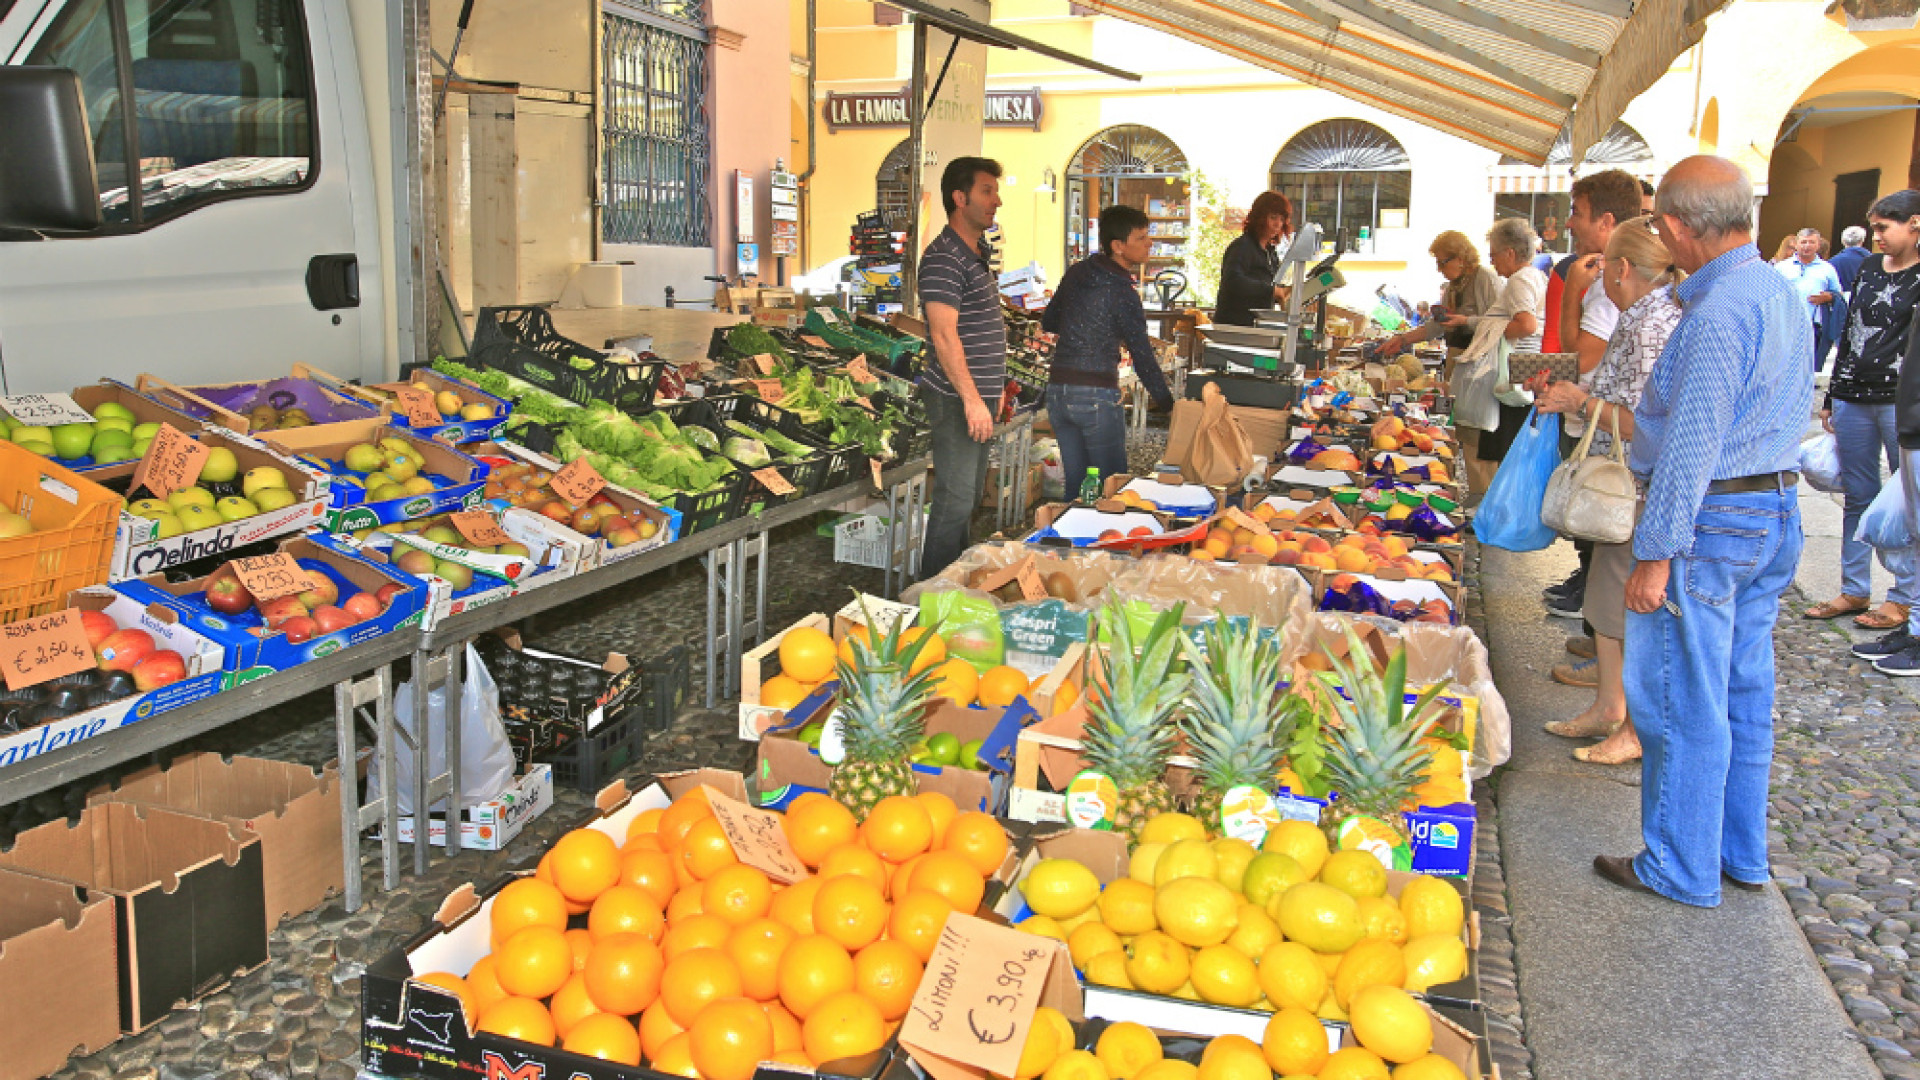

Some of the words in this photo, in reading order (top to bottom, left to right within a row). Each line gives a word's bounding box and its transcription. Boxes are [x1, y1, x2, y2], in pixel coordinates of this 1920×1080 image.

[831, 99, 851, 124] LA
[984, 96, 1034, 121] UNESA
[134, 528, 235, 575] Melinda
[1011, 629, 1056, 646] Green
[13, 650, 33, 674] €
[0, 717, 107, 768] arlene
[986, 960, 1027, 1013] 3,90
[967, 1008, 1016, 1044] €
